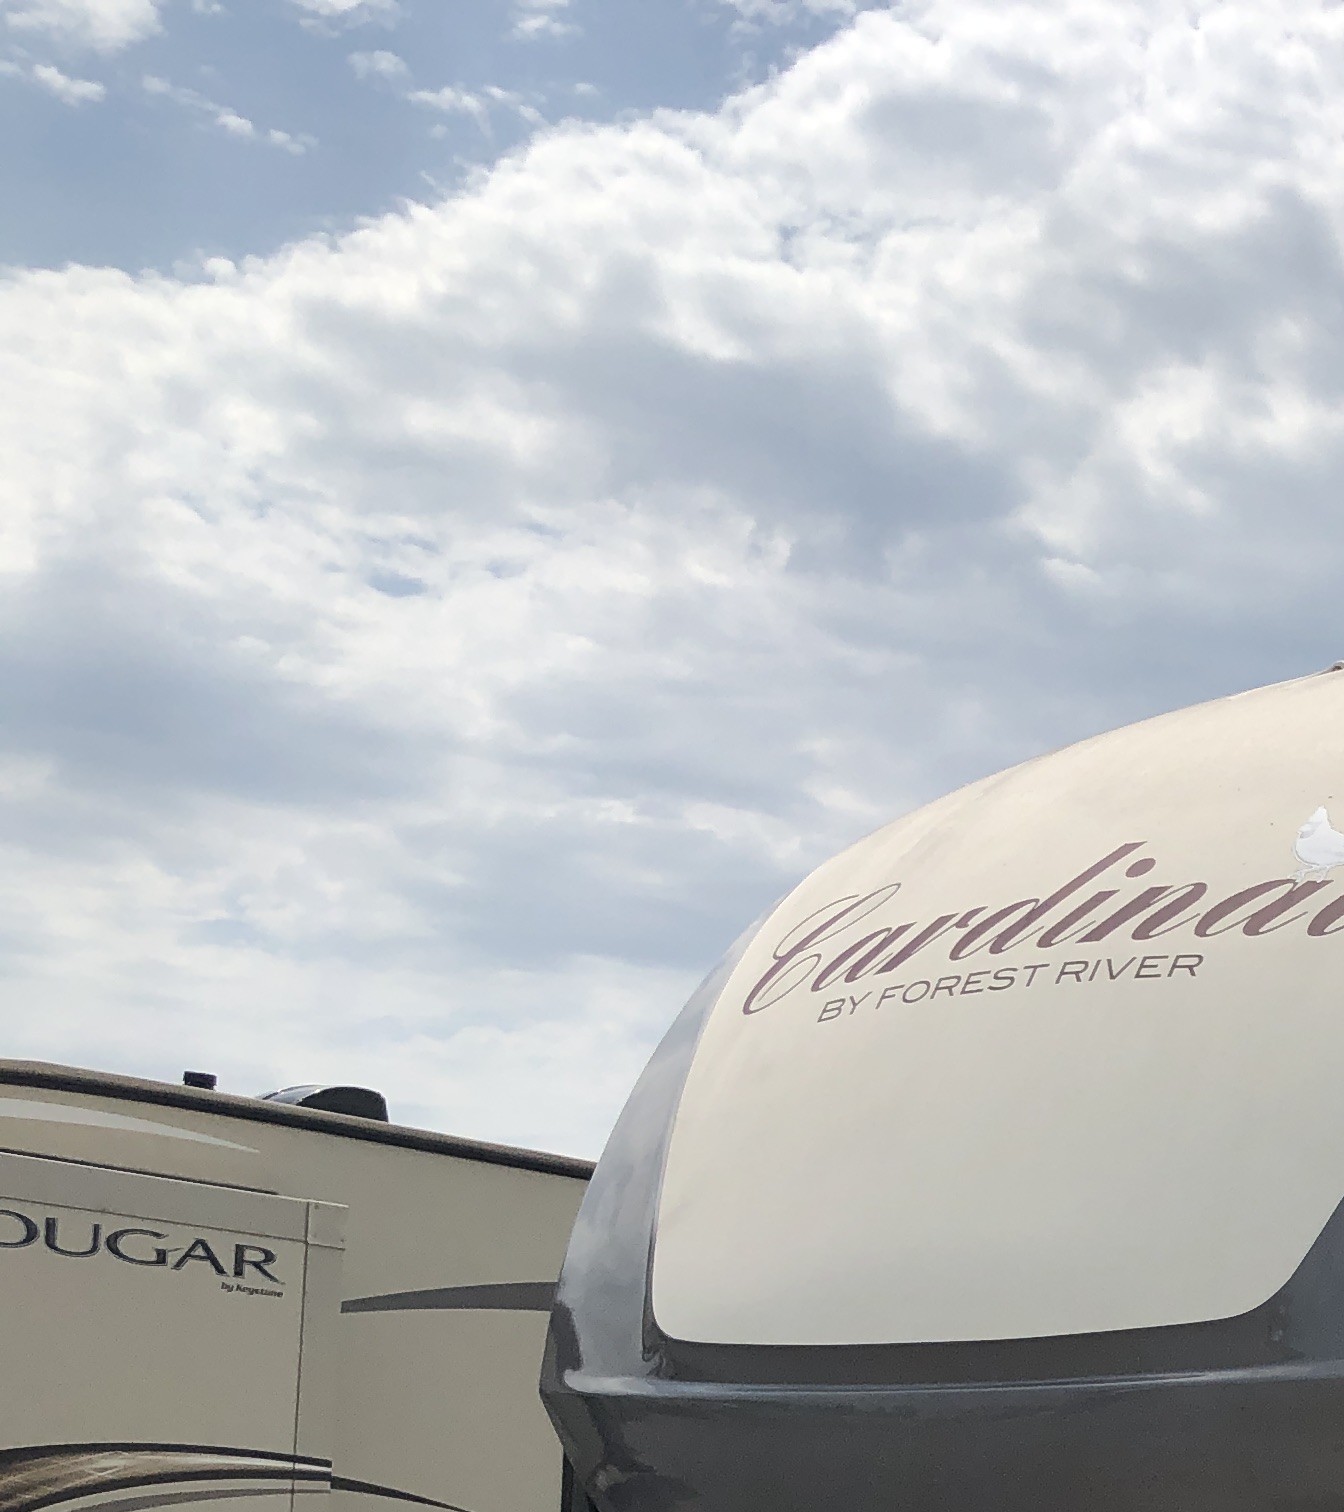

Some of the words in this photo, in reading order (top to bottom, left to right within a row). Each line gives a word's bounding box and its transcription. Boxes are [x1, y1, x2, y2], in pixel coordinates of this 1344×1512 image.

[816, 991, 873, 1024] BY
[875, 963, 1050, 1011] FOREST
[1054, 953, 1204, 986] RIVER
